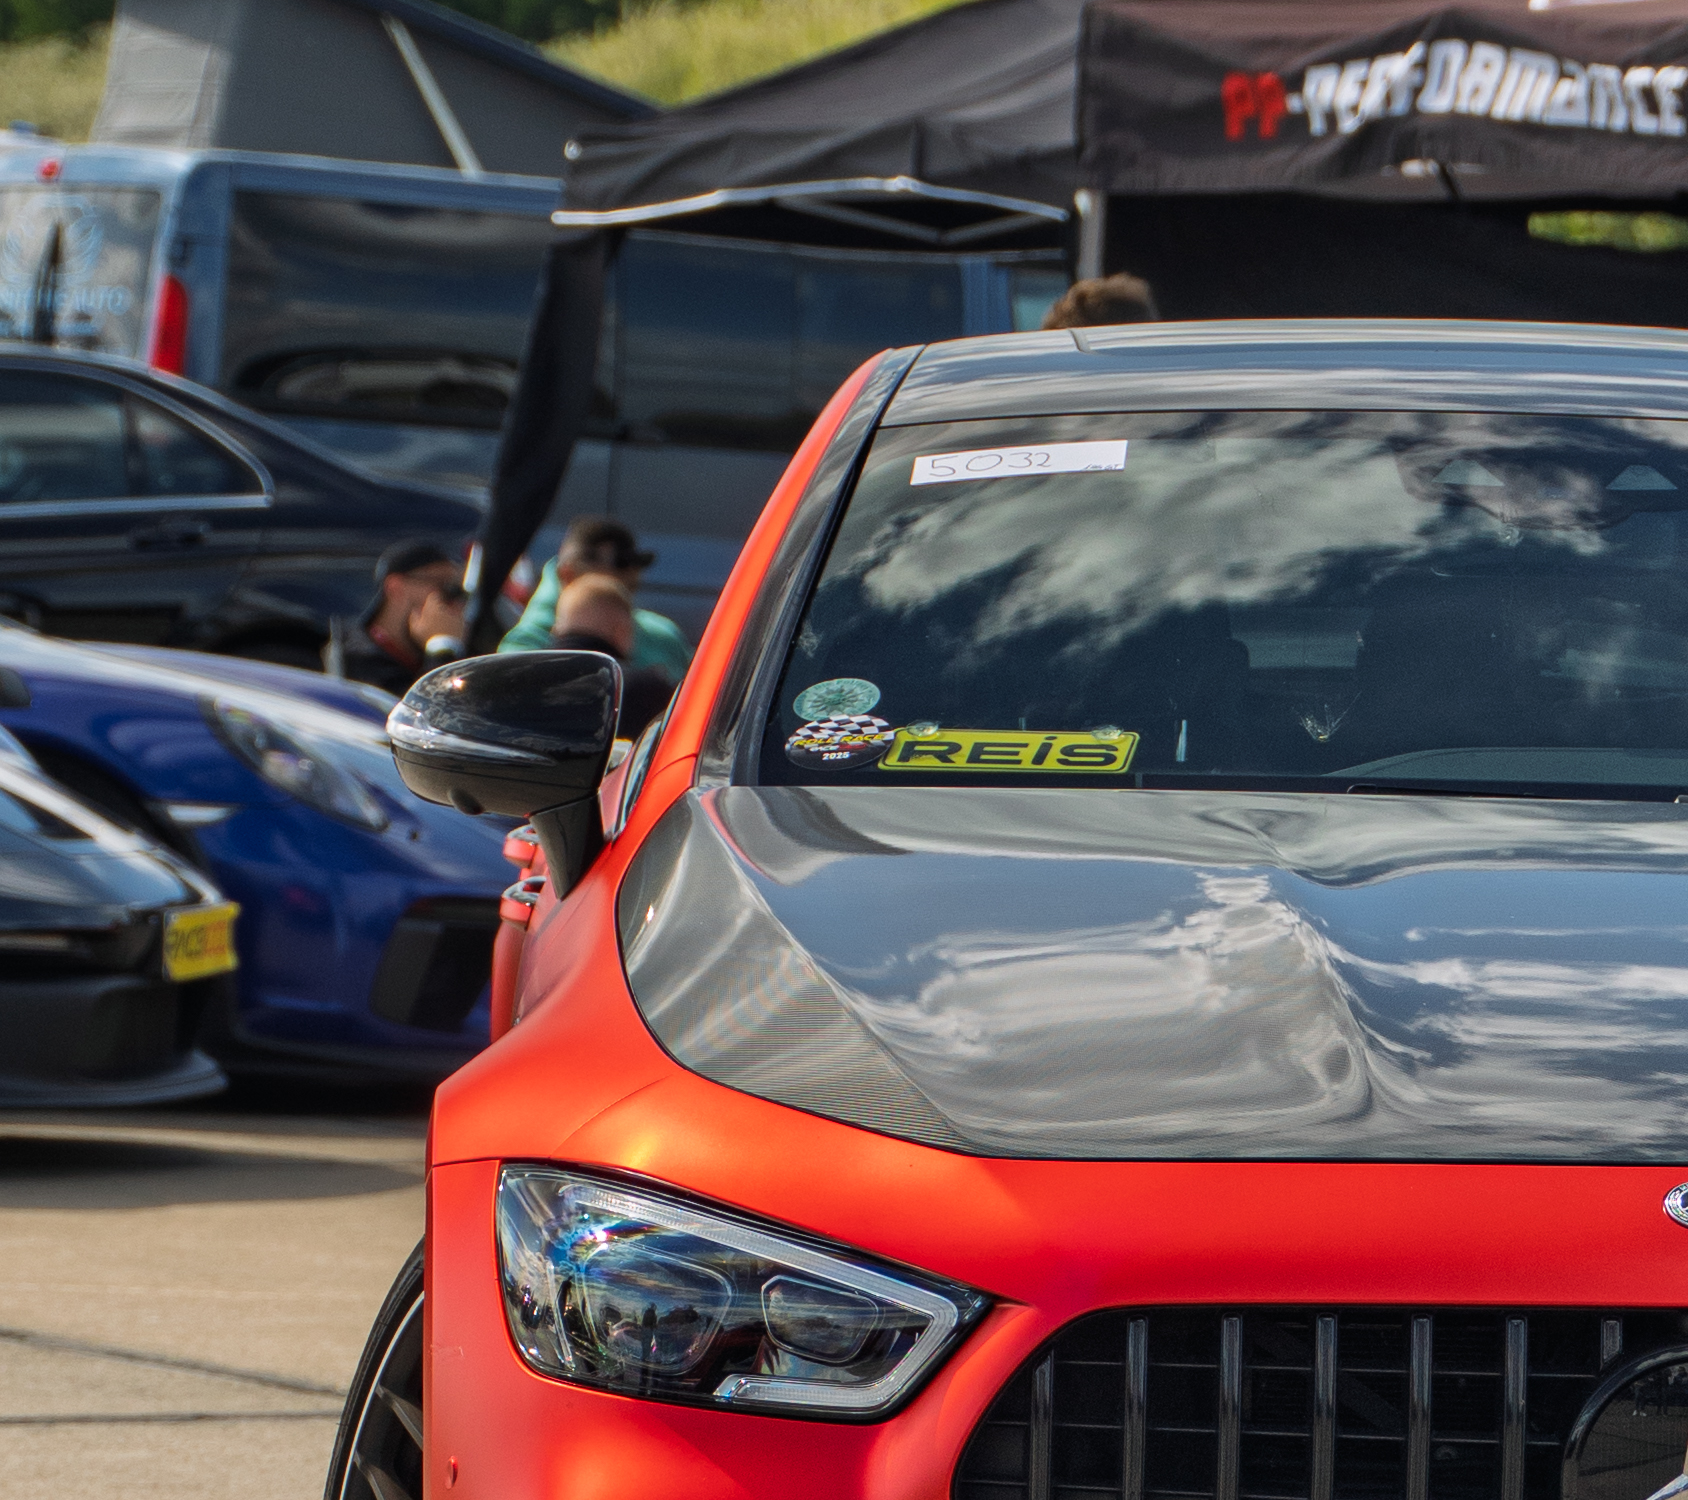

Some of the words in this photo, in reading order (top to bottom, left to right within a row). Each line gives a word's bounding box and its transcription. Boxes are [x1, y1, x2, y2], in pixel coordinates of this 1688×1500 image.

[929, 452, 1051, 477] 5032
[793, 736, 835, 746] ROLL
[840, 733, 885, 743] RACE
[822, 751, 850, 760] 2025
